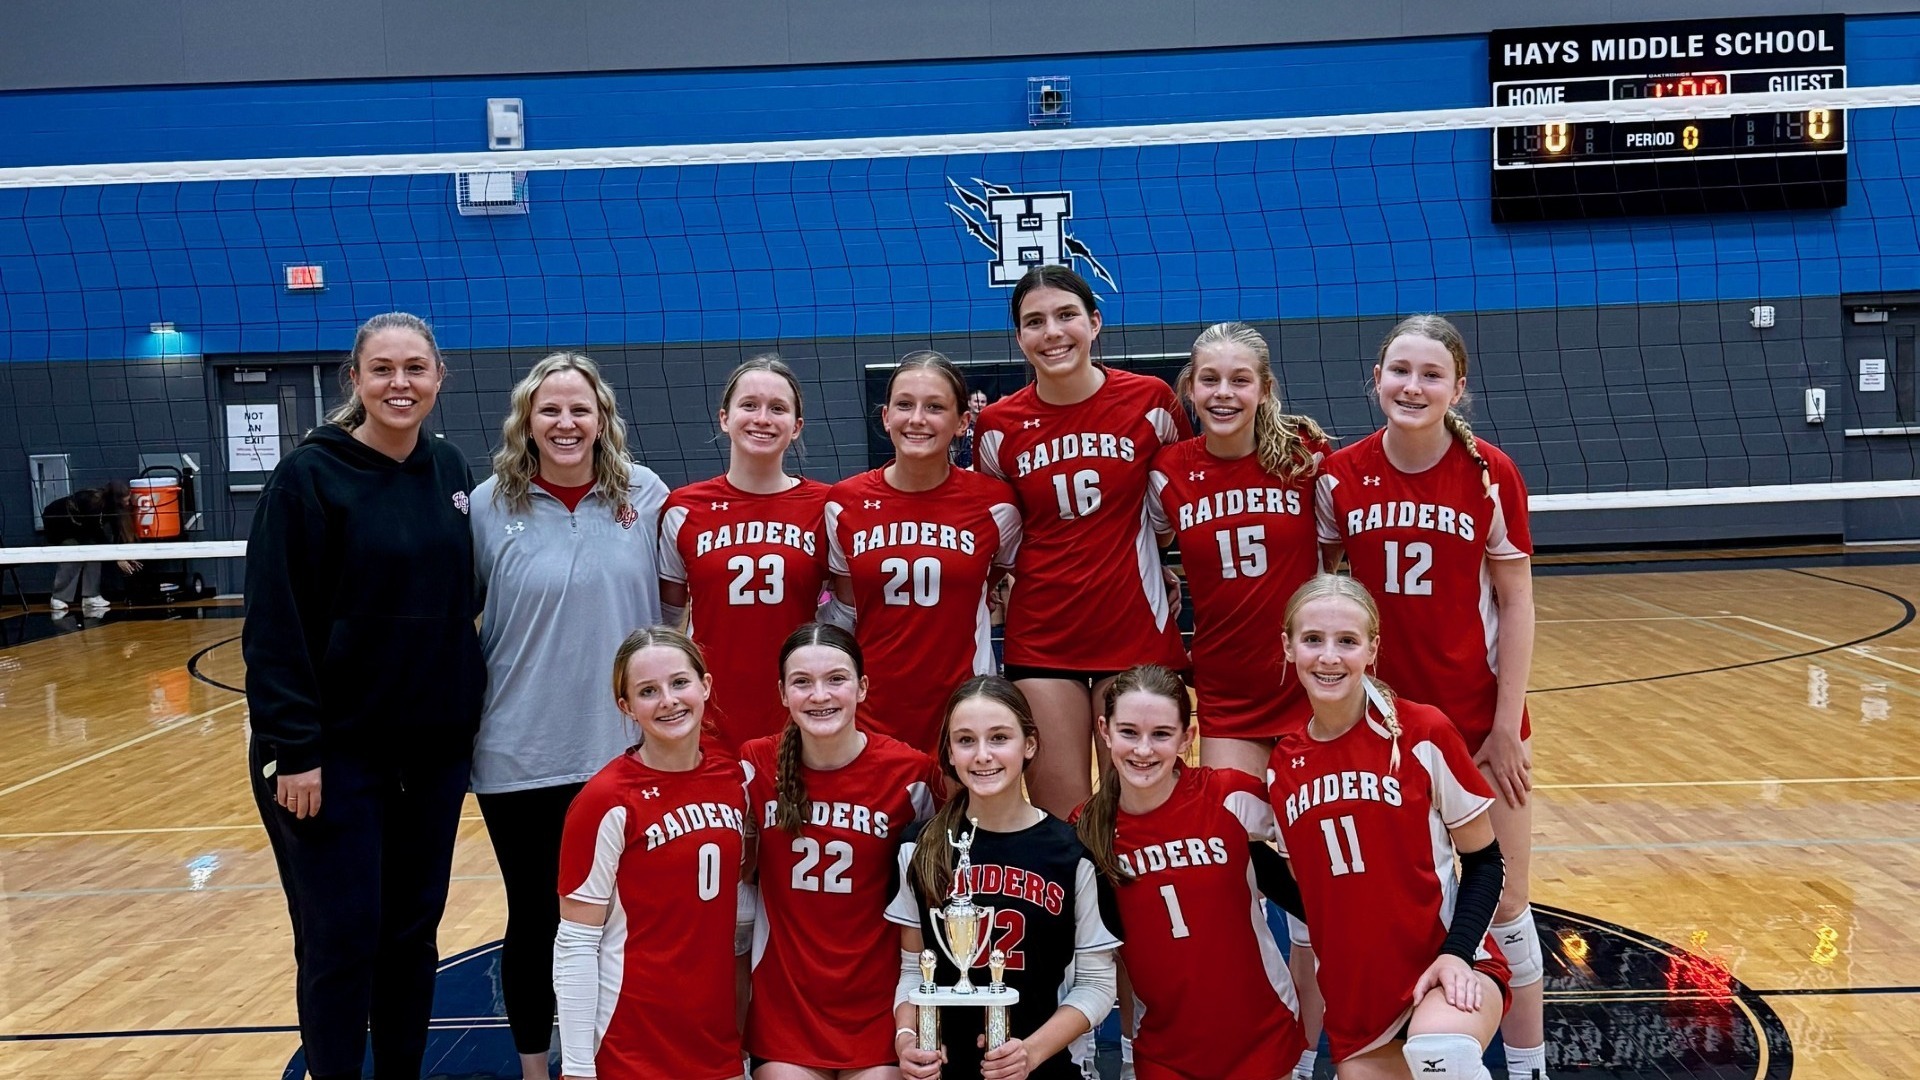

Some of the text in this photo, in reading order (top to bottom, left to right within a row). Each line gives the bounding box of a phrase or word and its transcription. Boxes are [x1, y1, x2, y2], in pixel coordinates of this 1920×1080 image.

[1504, 29, 1834, 66] HAYS MIDDLE SCHOOL
[1508, 86, 1566, 107] HOME
[1768, 73, 1834, 94] GUEST
[1626, 132, 1675, 147] PERIOD
[1682, 125, 1699, 150] 0
[988, 191, 1075, 288] H
[244, 412, 264, 420] NOT
[248, 424, 262, 432] AN
[244, 436, 265, 445] EXIT
[1016, 432, 1135, 478] RAIDERS
[1052, 469, 1101, 520] 16
[1179, 487, 1300, 531] RAIDERS
[697, 521, 816, 557] RAIDERS
[853, 521, 976, 556] RAIDERS
[1348, 501, 1475, 541] RAIDERS
[1216, 524, 1268, 579] 15
[1384, 540, 1433, 596] 12
[727, 554, 785, 605] 23
[881, 556, 942, 607] 20
[763, 800, 889, 839] RDERS
[1285, 771, 1403, 827] RAIDERS
[645, 802, 744, 852] RAIDERS
[1320, 815, 1366, 876] 11
[698, 842, 721, 901] 0
[791, 836, 854, 894] 22
[1117, 836, 1228, 877] AIDERS
[1159, 884, 1190, 939] 1
